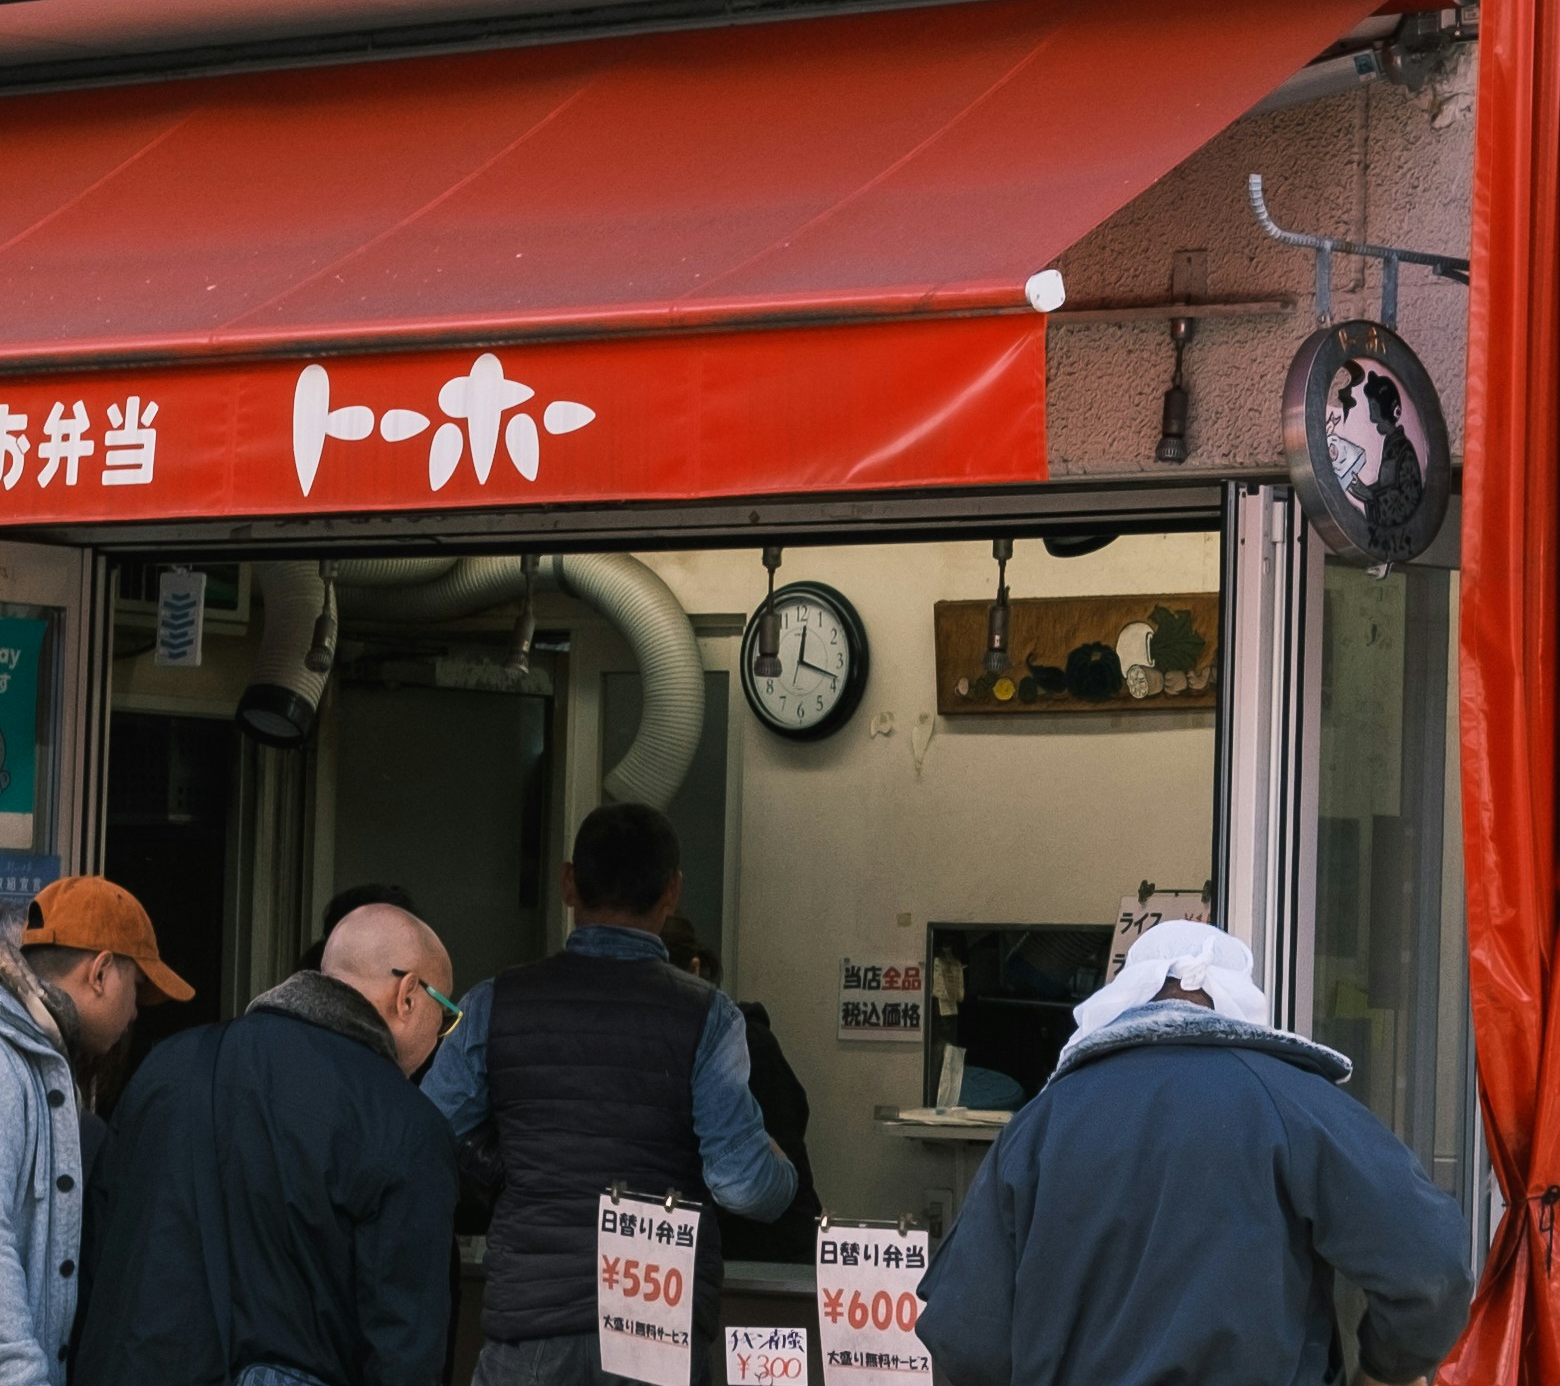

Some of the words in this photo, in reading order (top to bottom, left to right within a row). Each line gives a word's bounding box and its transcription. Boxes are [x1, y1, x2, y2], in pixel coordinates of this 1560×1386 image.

[293, 352, 597, 498] トーホー
[796, 604, 808, 622] 12
[818, 611, 823, 628] 1
[830, 627, 838, 645] 2
[835, 653, 844, 670] 3
[766, 679, 774, 695] 8
[830, 677, 837, 693] 4
[779, 695, 787, 712] 7
[796, 700, 805, 719] 6
[816, 694, 824, 712] 5
[843, 965, 922, 991] 当店全品
[842, 1001, 921, 1028] 税込価格
[600, 1209, 695, 1248] 日替り弁当
[820, 1239, 926, 1270] 日替り弁当
[602, 1254, 683, 1308] ¥550
[823, 1287, 919, 1333] ¥600
[603, 1315, 690, 1346] 大盛り無料サービス
[736, 1353, 803, 1380] ¥300
[827, 1350, 931, 1372] 大盛り無料サービス
